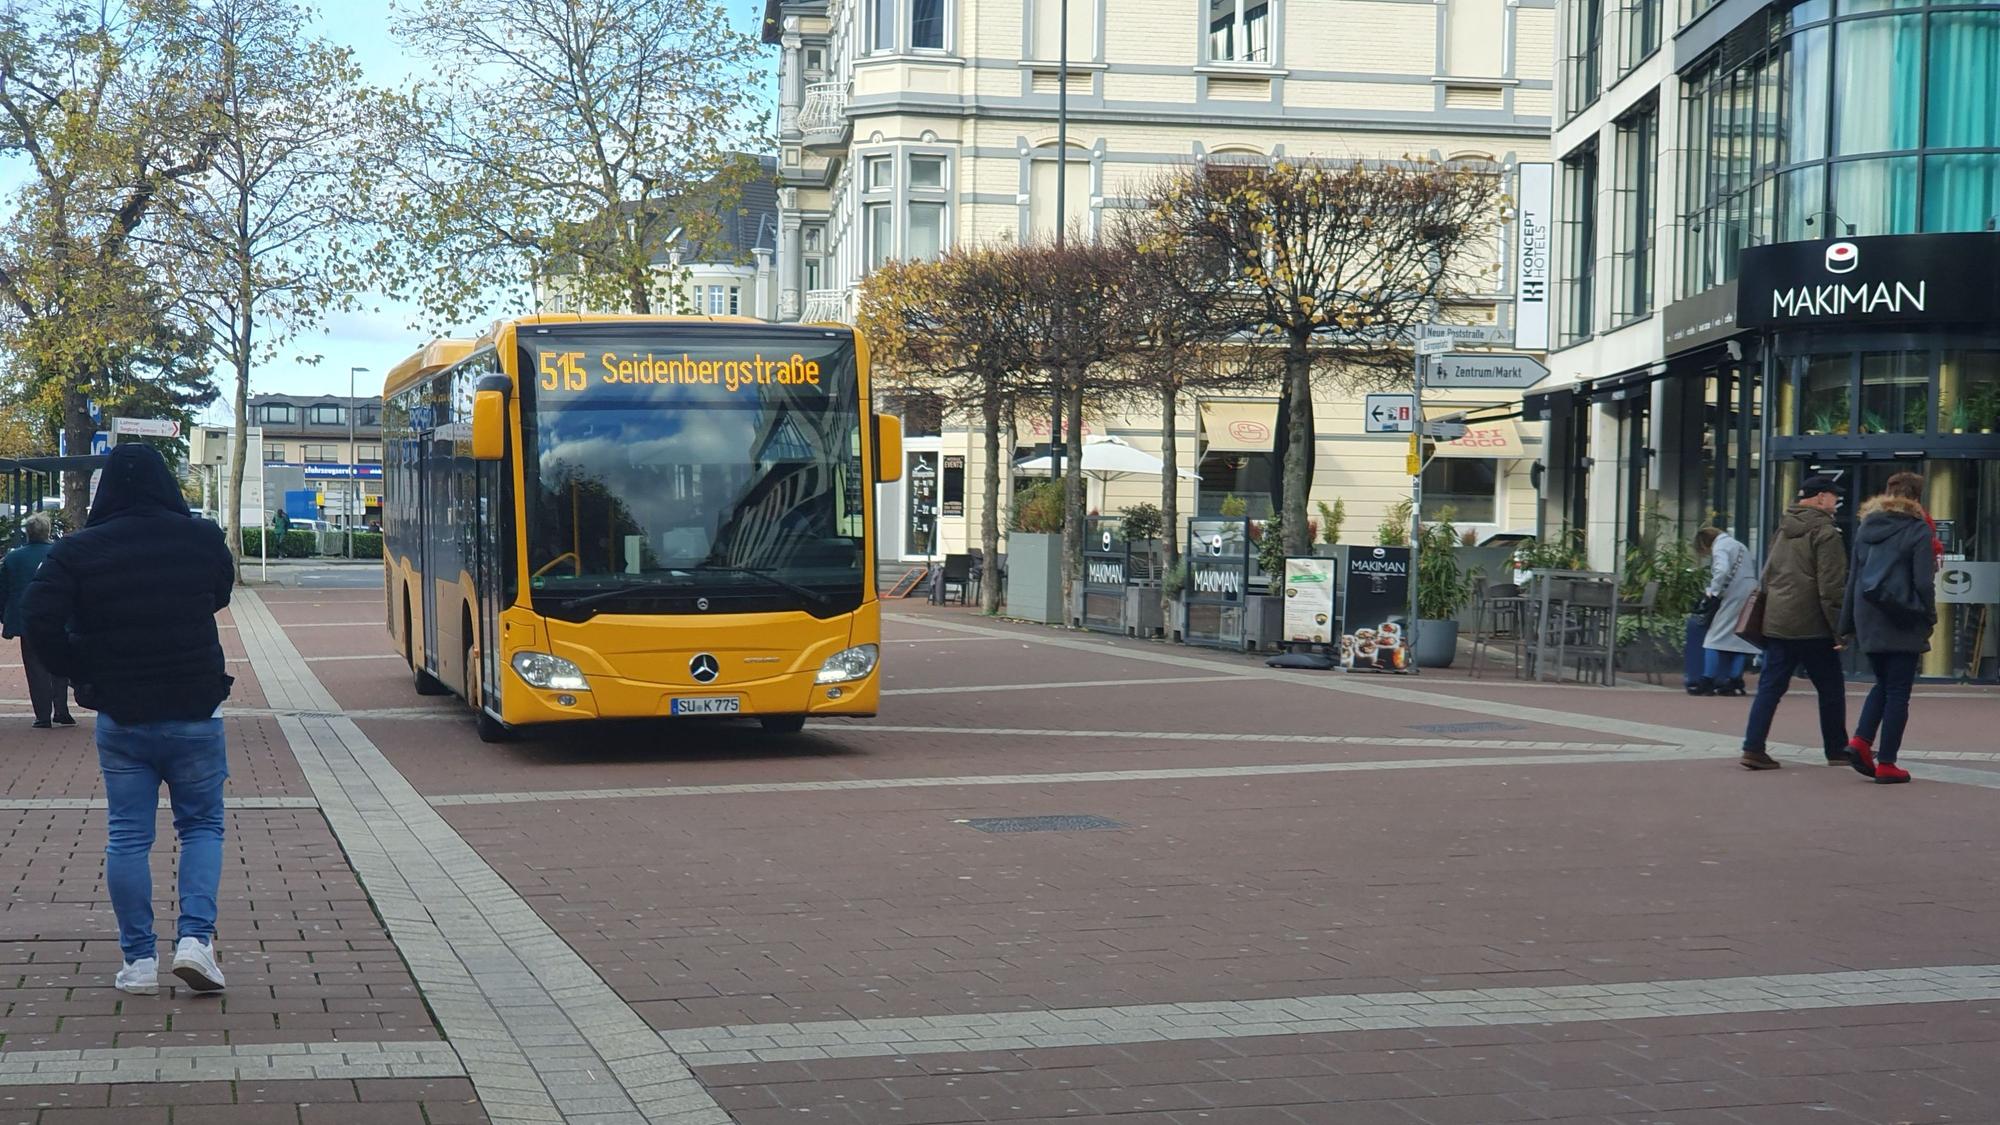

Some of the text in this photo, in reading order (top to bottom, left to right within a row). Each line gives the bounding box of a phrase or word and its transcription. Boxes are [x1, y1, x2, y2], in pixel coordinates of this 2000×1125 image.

[1523, 210, 1535, 277] KONCEPT
[1534, 225, 1546, 278] HOTELS
[1773, 280, 1926, 318] MAKIMAN
[1427, 327, 1485, 339] Neue Poststraße
[539, 352, 820, 392] 515 Seidenbergstraße
[1455, 365, 1522, 378] Zentrum/Markt
[1089, 563, 1123, 583] MAKIMAN
[1351, 560, 1406, 573] MAKIMAN
[1194, 570, 1239, 593] MAKIMAN
[678, 698, 739, 713] SU K 775
